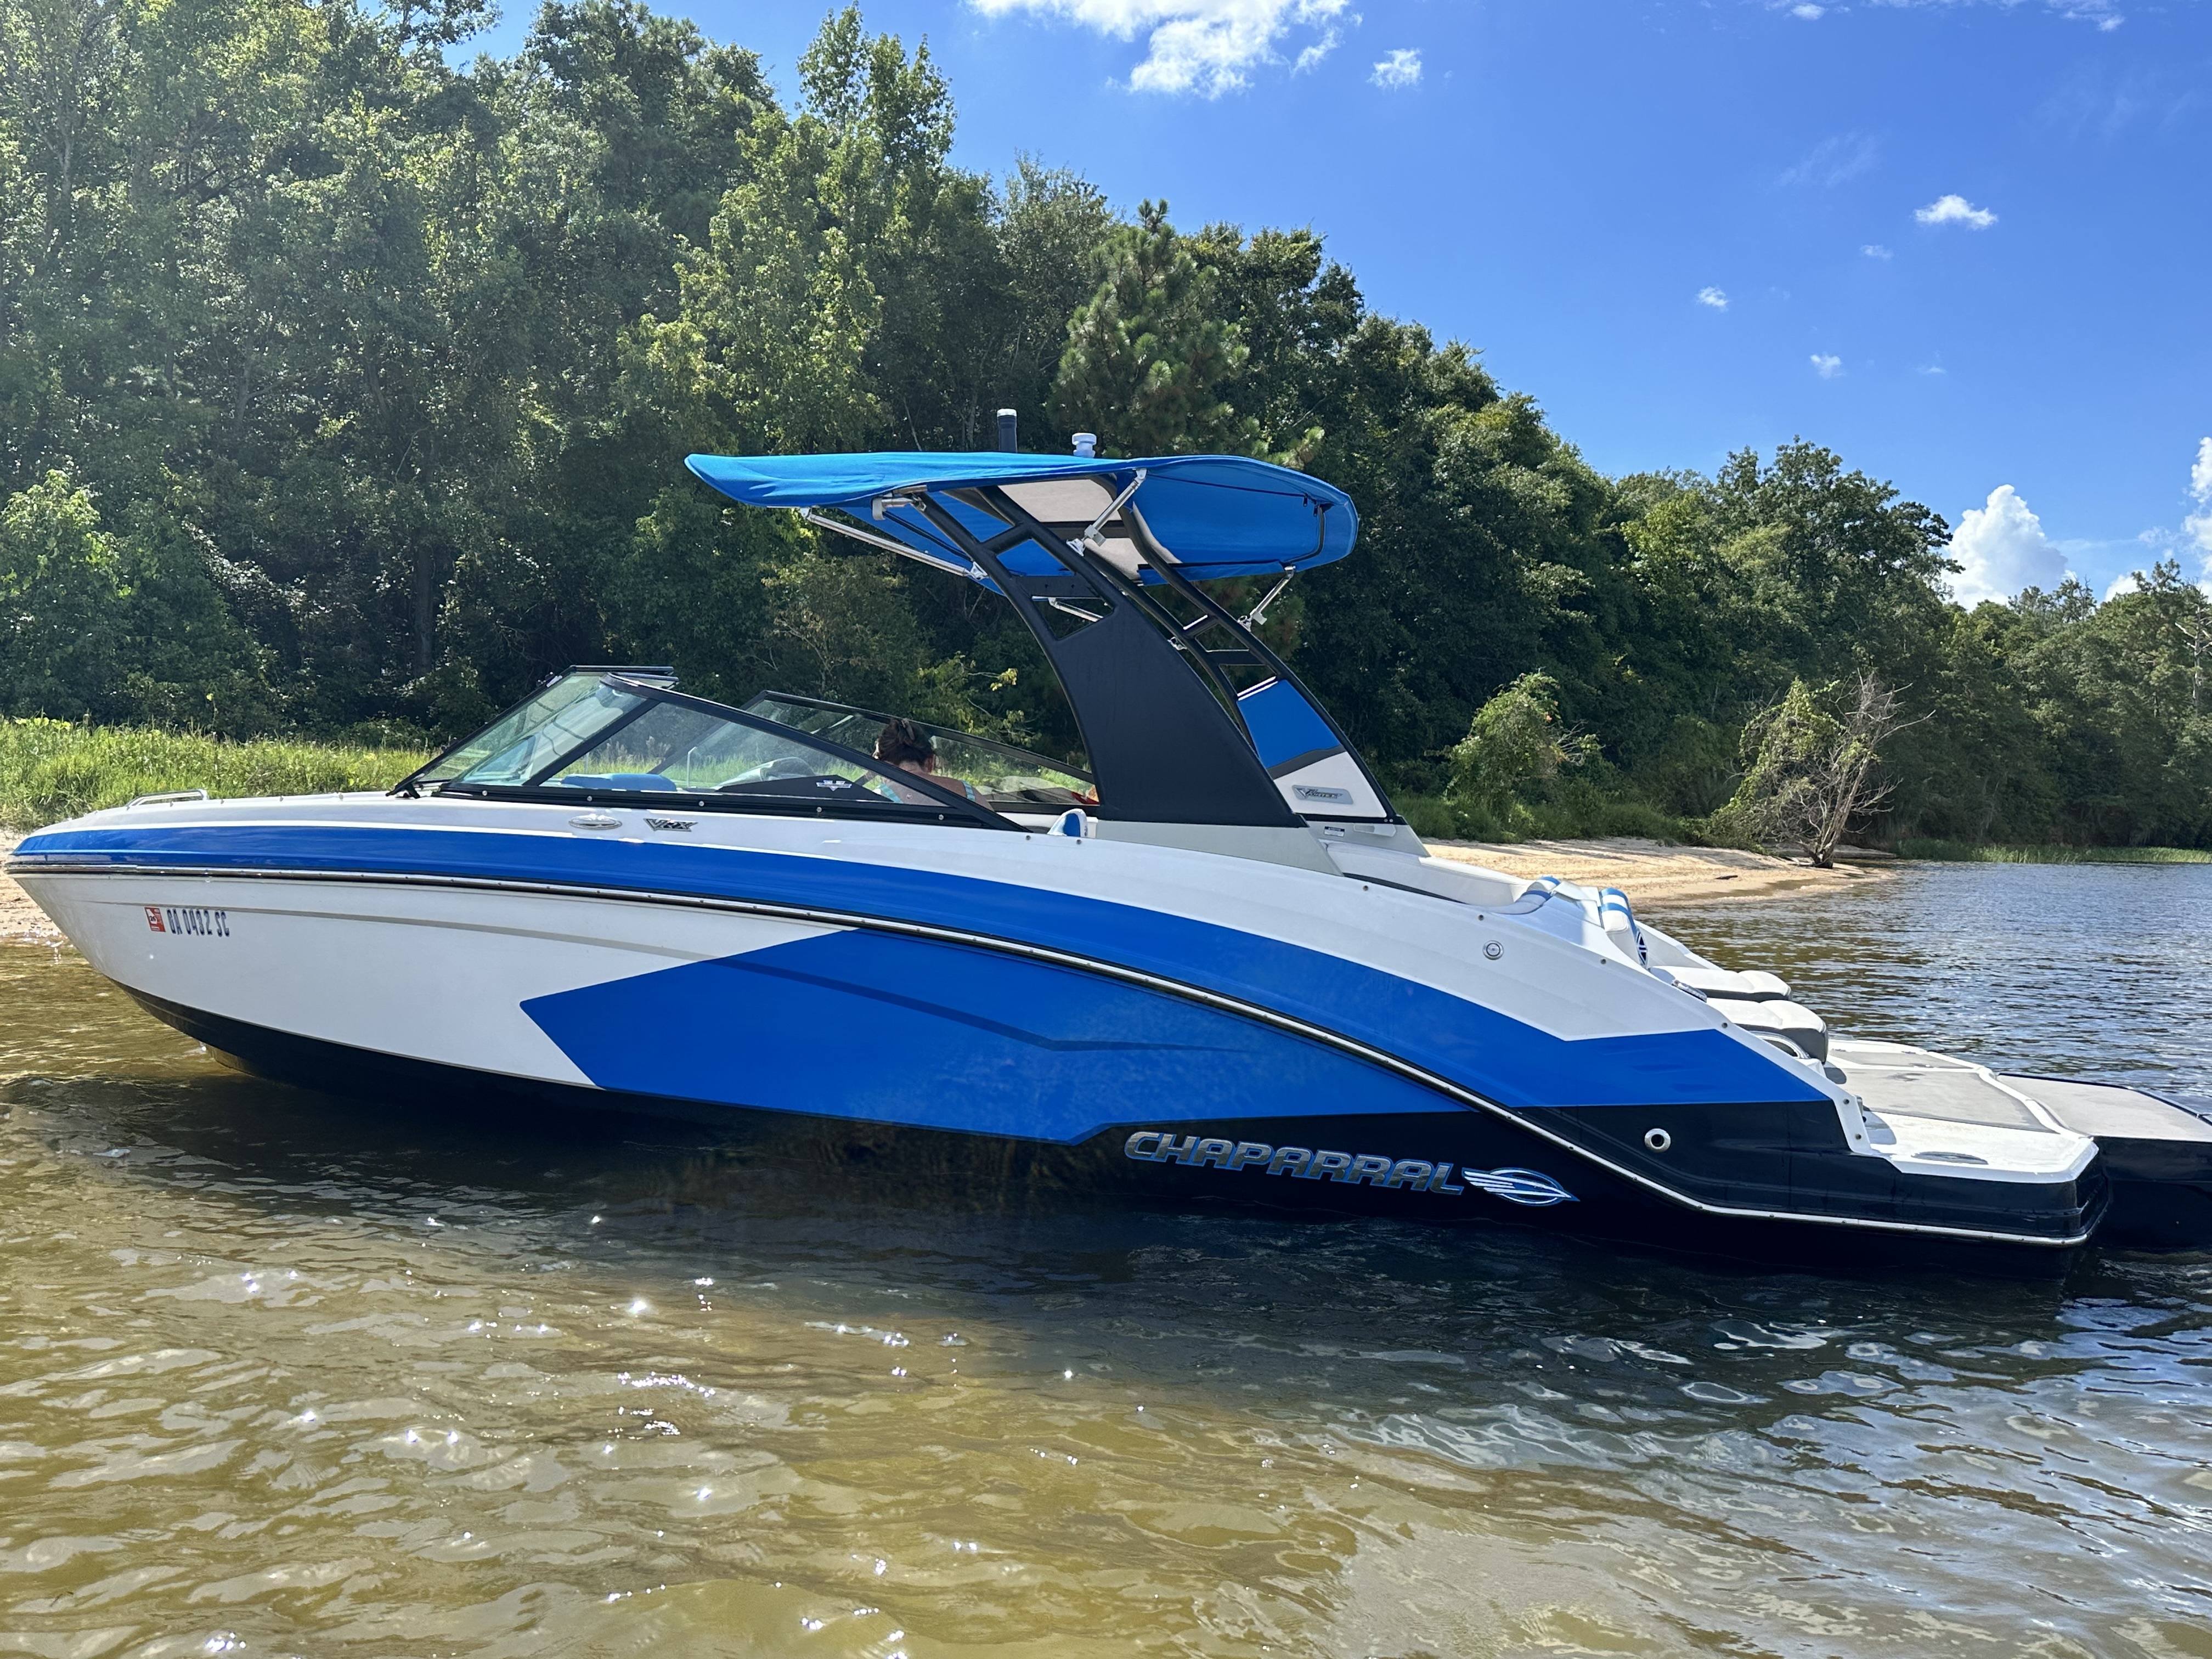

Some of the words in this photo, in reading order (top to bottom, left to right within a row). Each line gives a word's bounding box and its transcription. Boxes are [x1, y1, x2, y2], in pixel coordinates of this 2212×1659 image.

[167, 909, 183, 935] GA
[215, 911, 229, 937] SC
[1124, 1131, 1464, 1195] CHAPARRAL
